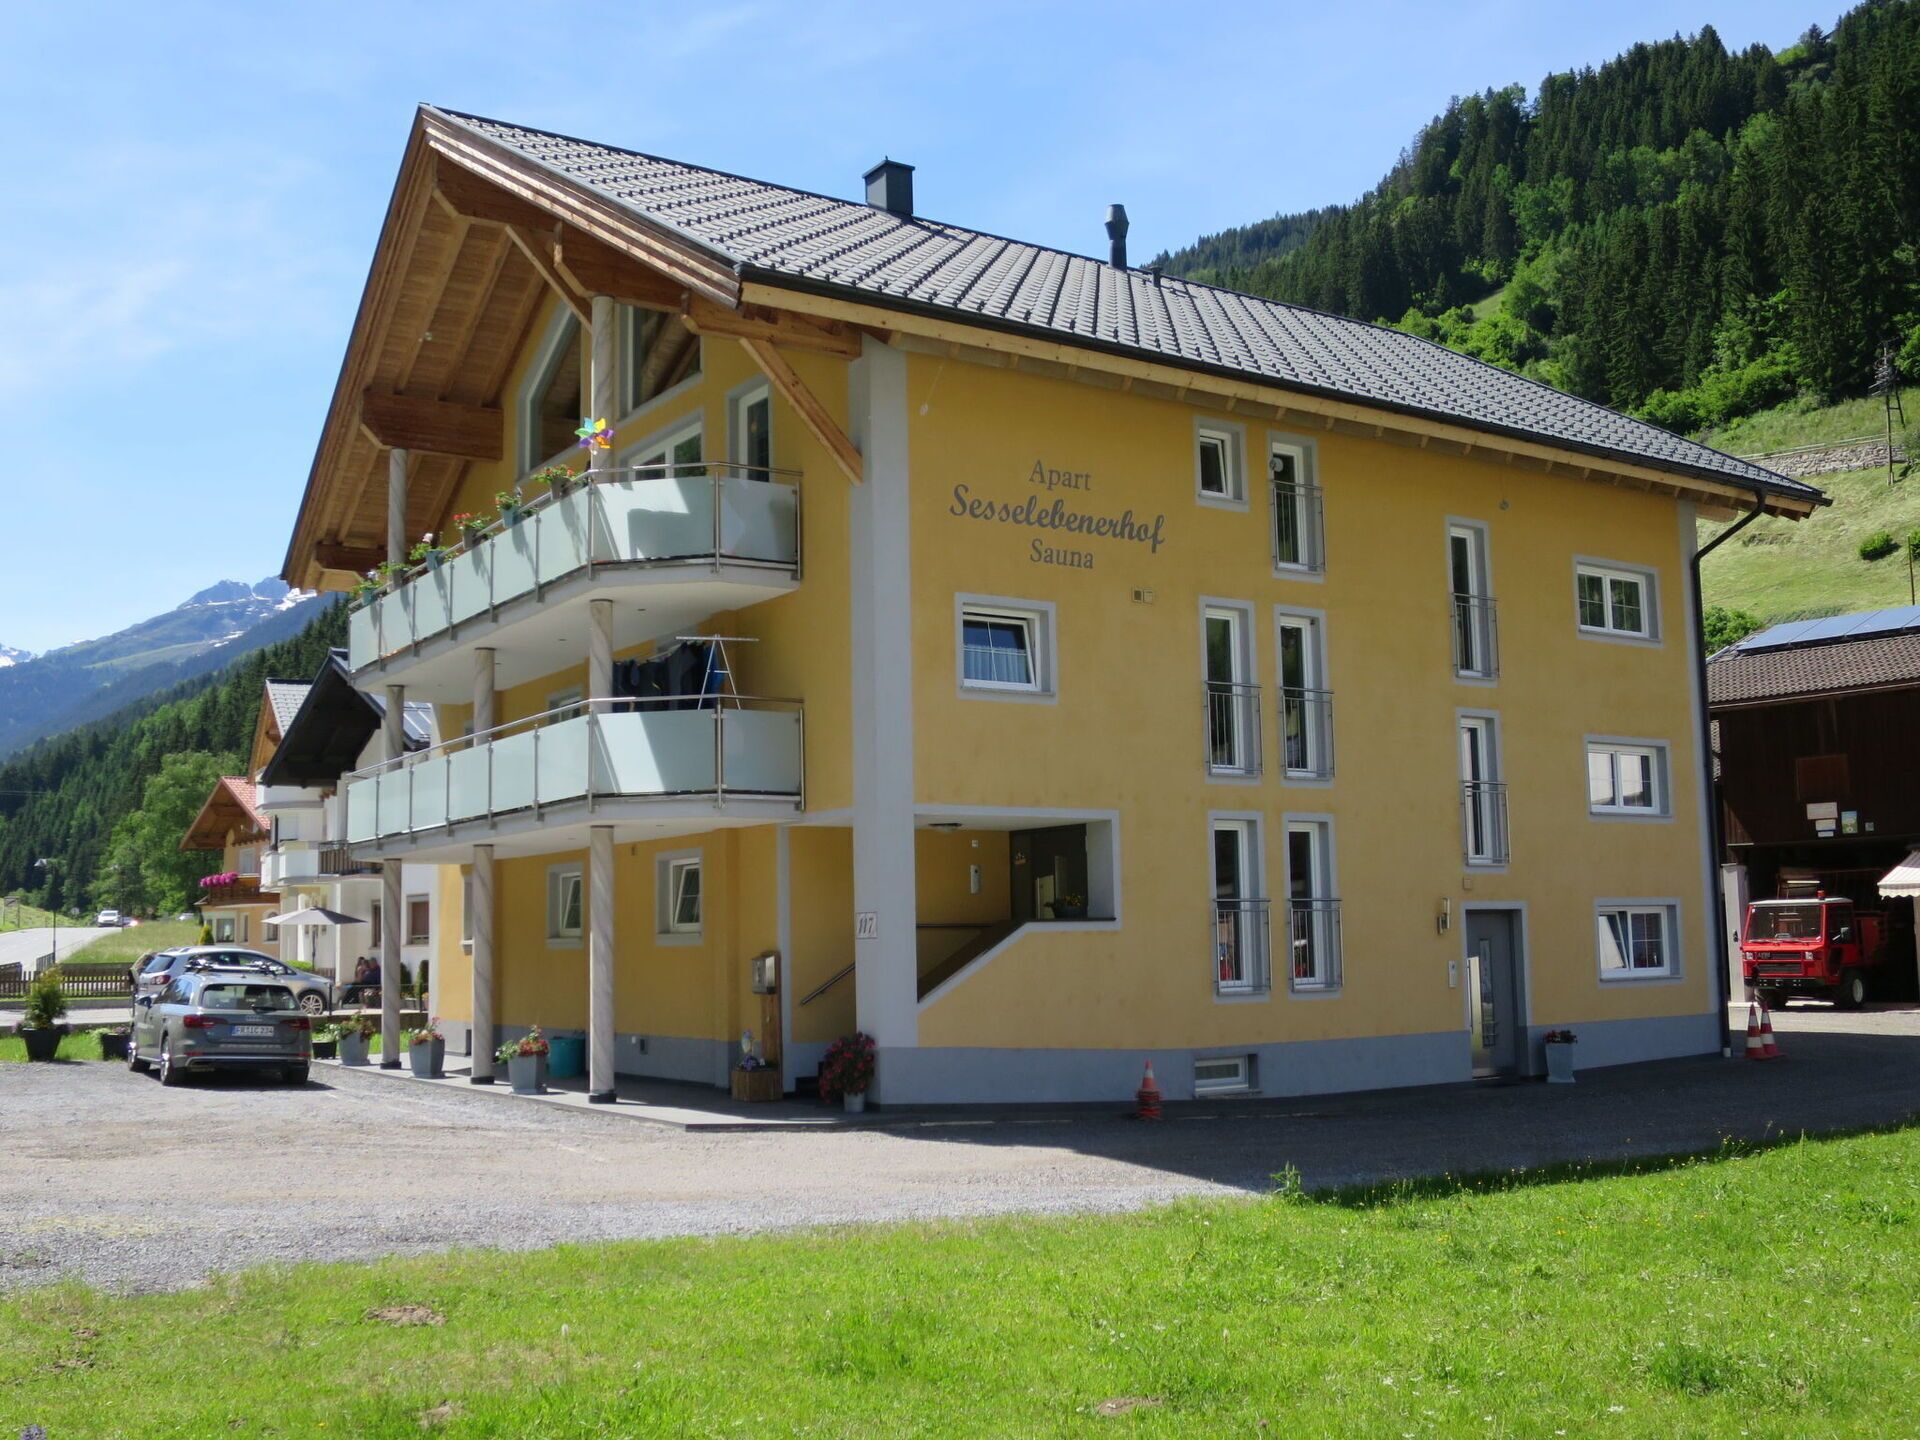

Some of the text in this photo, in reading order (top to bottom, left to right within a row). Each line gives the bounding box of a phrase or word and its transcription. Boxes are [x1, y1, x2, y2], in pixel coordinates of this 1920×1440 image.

[1029, 459, 1092, 491] Apart
[949, 483, 1165, 553] Sesselebenerhof
[1030, 538, 1094, 569] Sauna
[858, 917, 874, 934] 117
